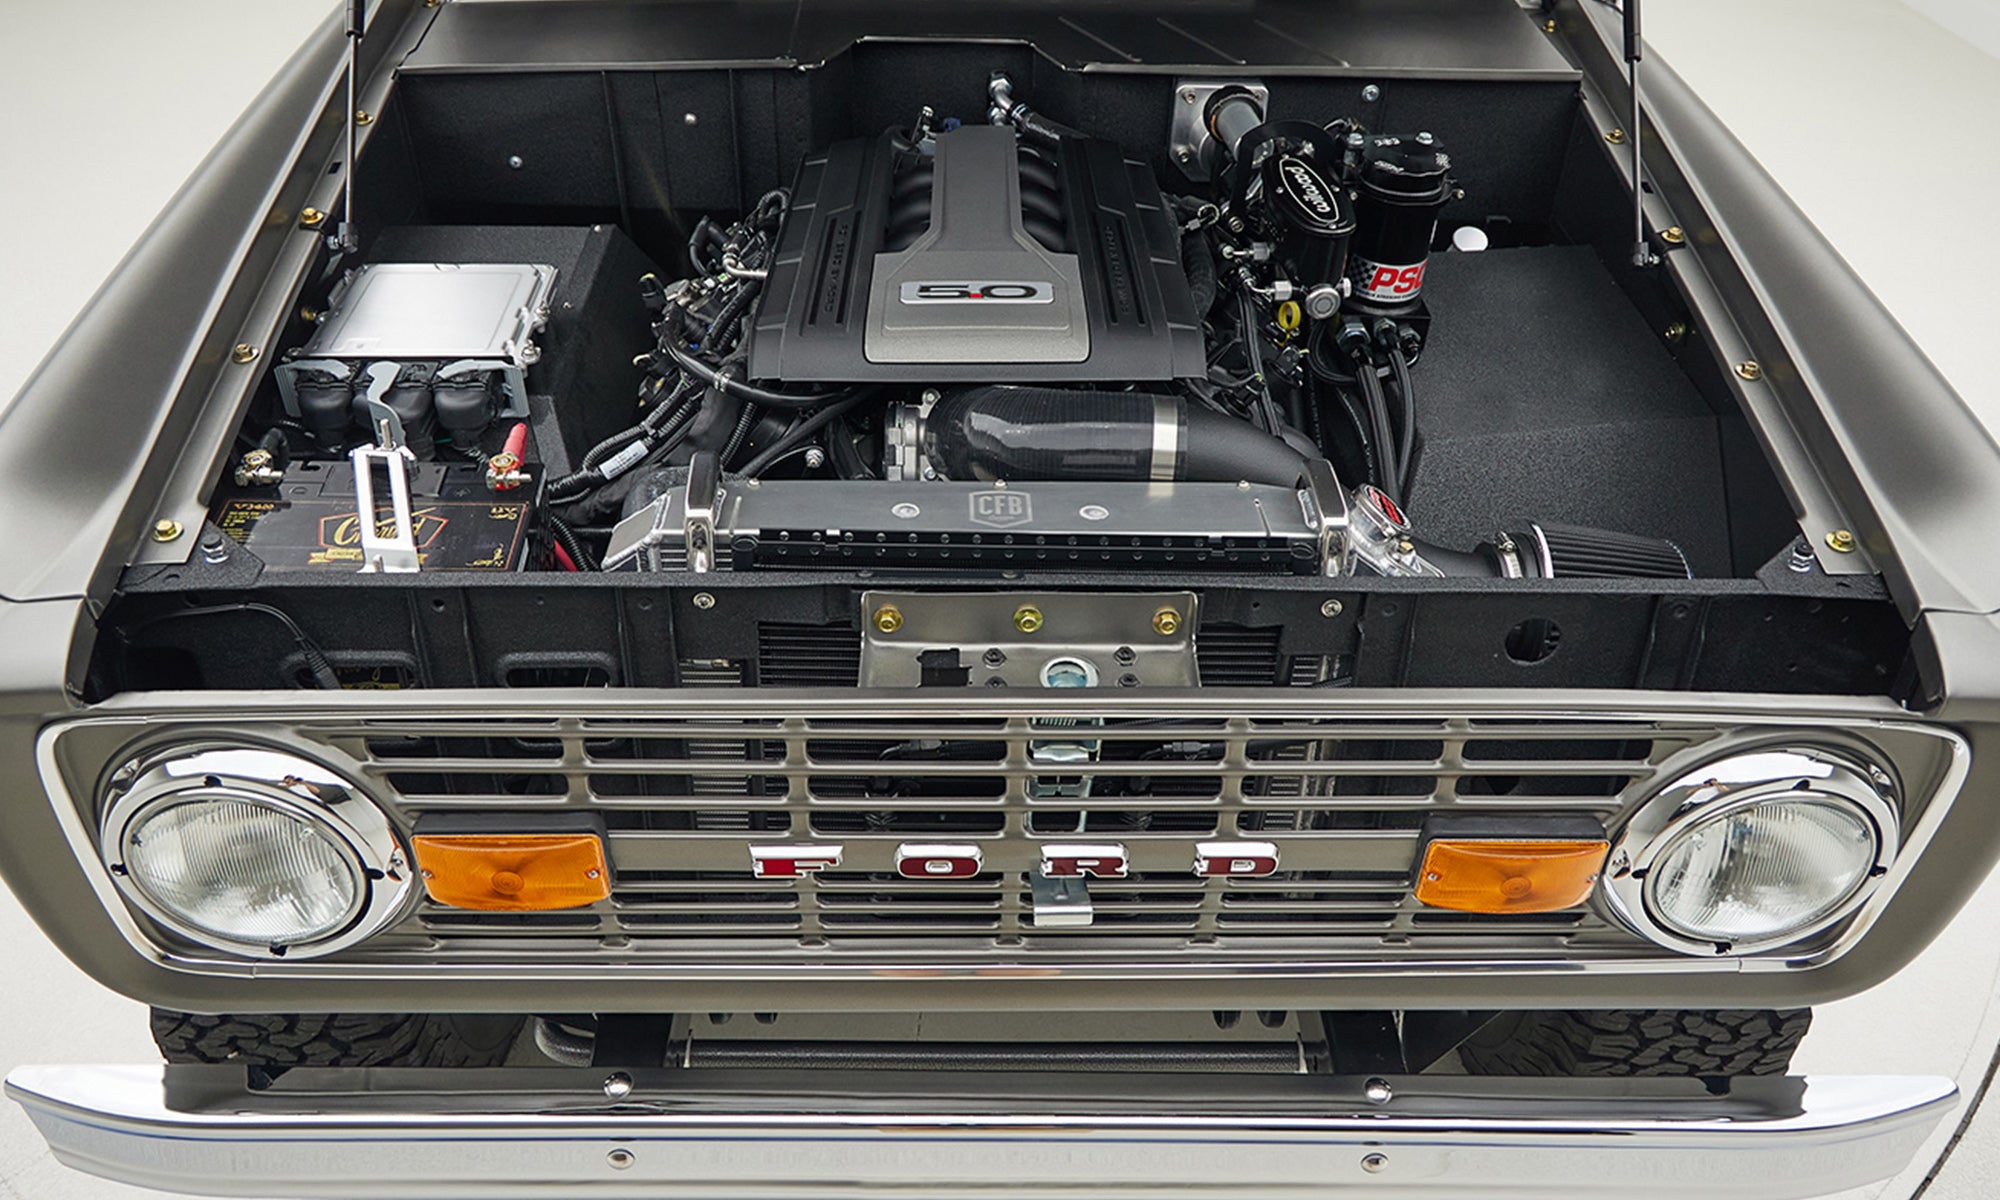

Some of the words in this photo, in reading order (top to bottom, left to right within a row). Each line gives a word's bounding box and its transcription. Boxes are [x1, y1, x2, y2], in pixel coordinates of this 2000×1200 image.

[1285, 166, 1331, 213] wilwood
[917, 284, 1038, 299] 5.0
[979, 495, 1022, 515] CFB
[749, 843, 1280, 878] FORD
